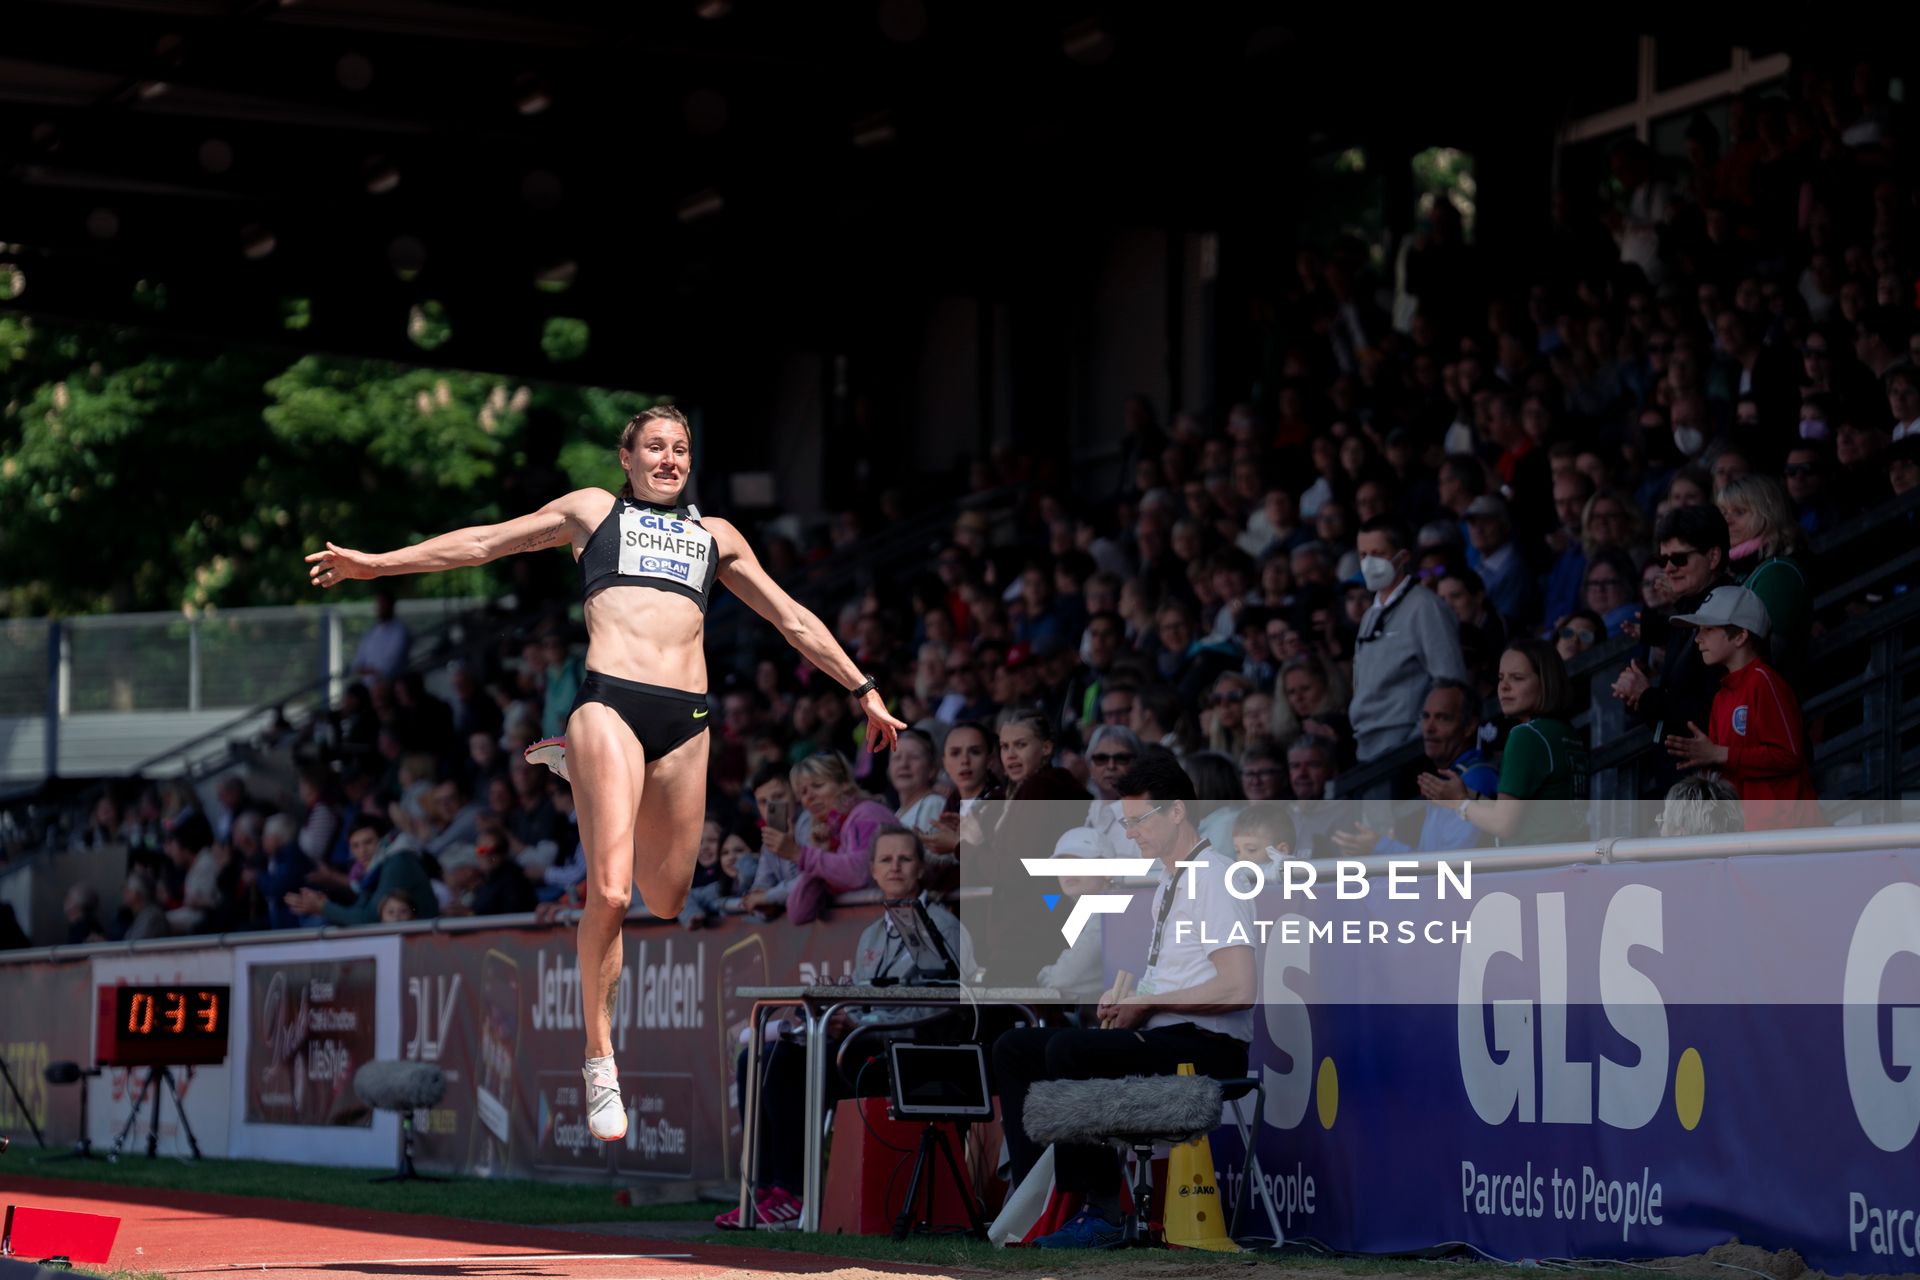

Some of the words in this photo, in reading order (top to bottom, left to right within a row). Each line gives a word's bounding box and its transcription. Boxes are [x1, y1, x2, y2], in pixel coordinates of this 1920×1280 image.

[626, 530, 707, 561] SCHÄFER
[661, 561, 688, 575] PLAN
[532, 948, 583, 1030] Jetzt
[637, 938, 705, 1030] laden!
[1192, 1186, 1215, 1195] JAKO
[1461, 1160, 1545, 1218] Parcels
[1552, 1167, 1576, 1220] to
[1581, 1165, 1664, 1243] People
